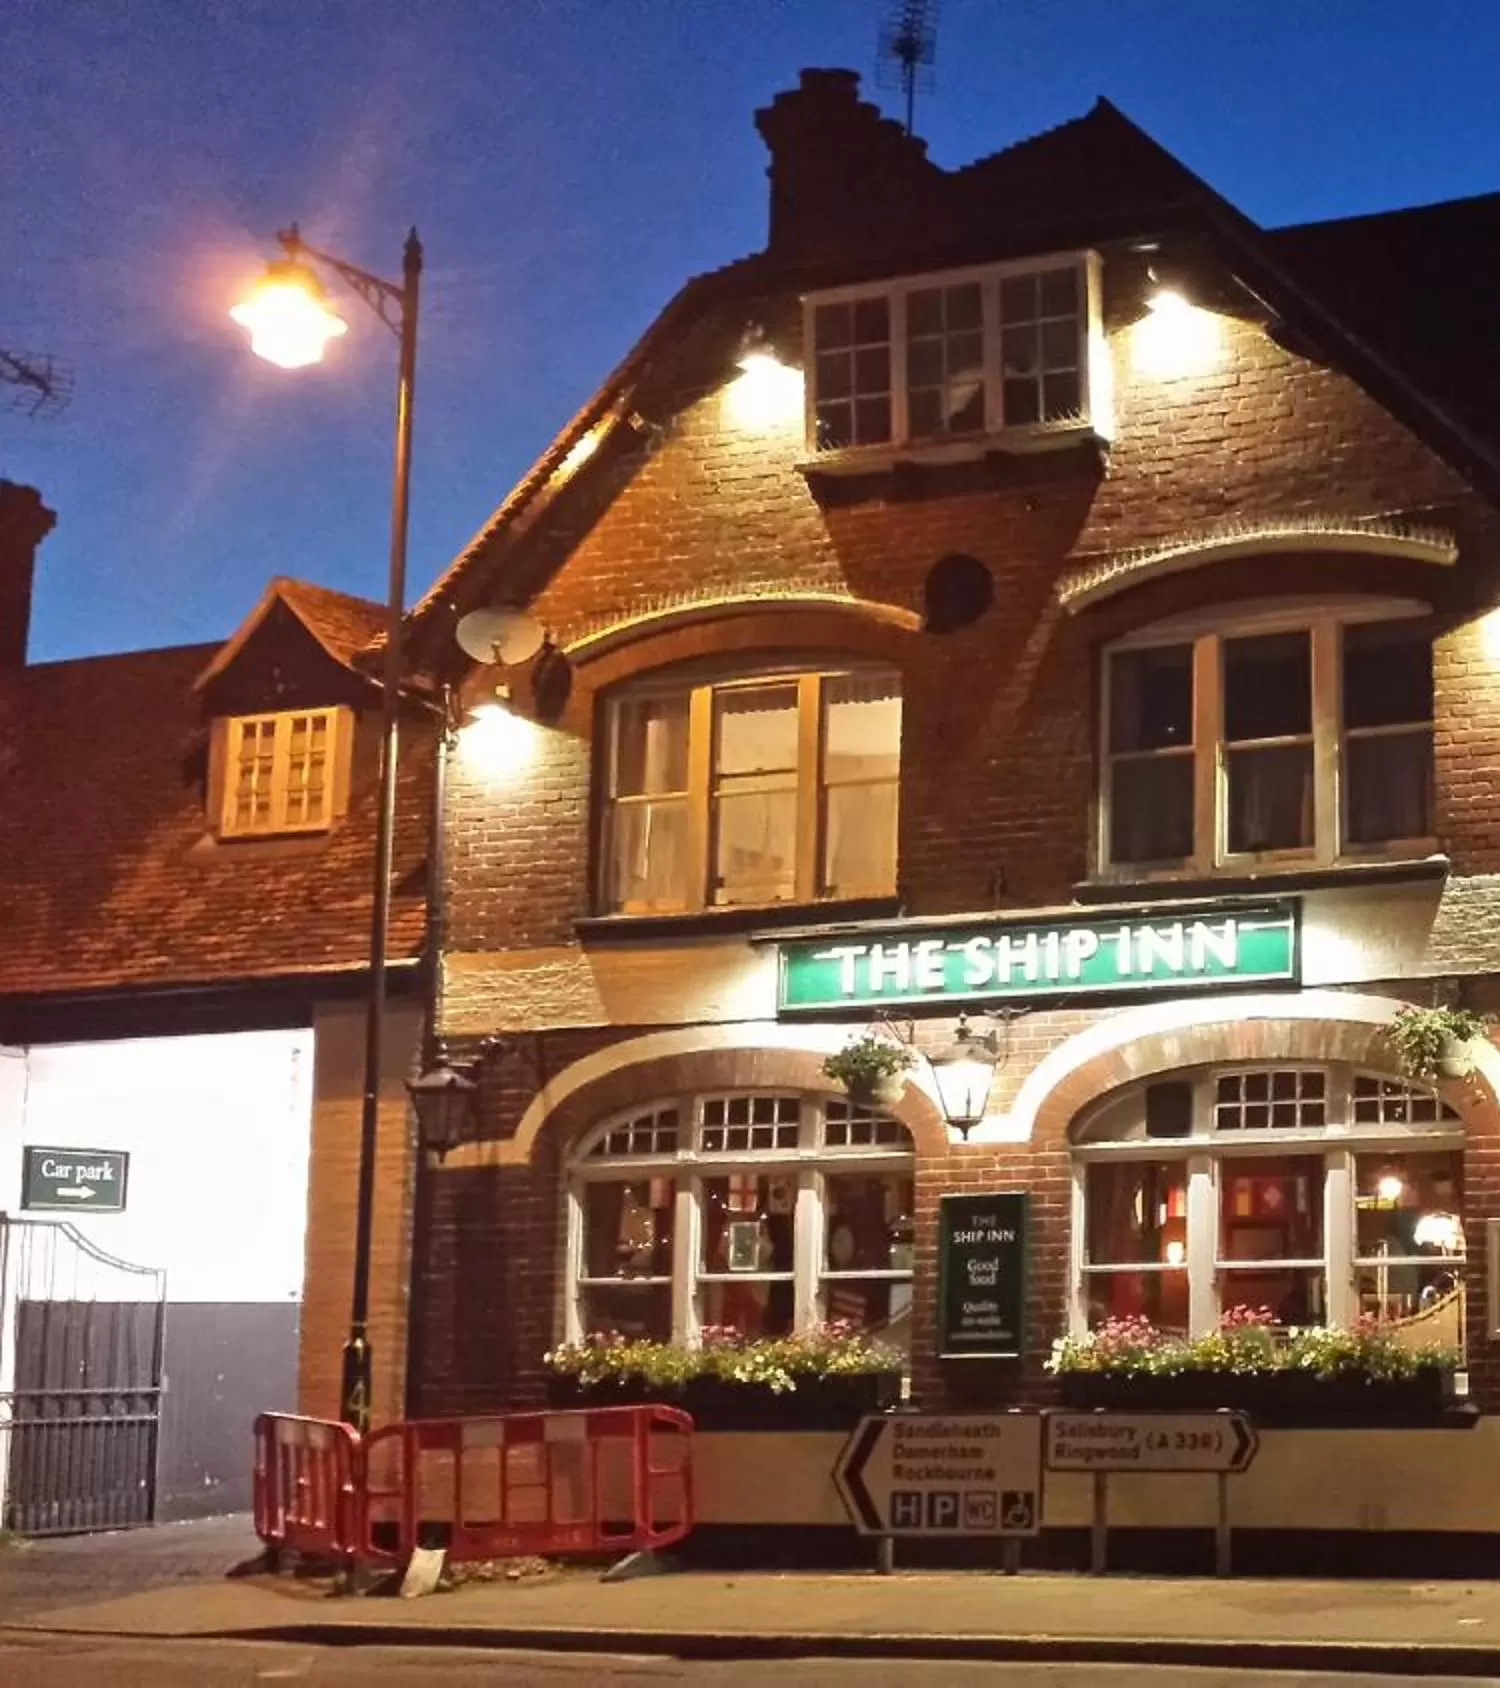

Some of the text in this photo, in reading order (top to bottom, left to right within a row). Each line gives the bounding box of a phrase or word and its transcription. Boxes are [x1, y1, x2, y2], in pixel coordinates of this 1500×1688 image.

[833, 919, 1238, 993] THE SHIP INN
[41, 1159, 114, 1184] Car park
[971, 1215, 997, 1227] THE
[953, 1229, 1016, 1244] SHIP INN
[967, 1257, 999, 1272] Good
[935, 1496, 956, 1524] P
